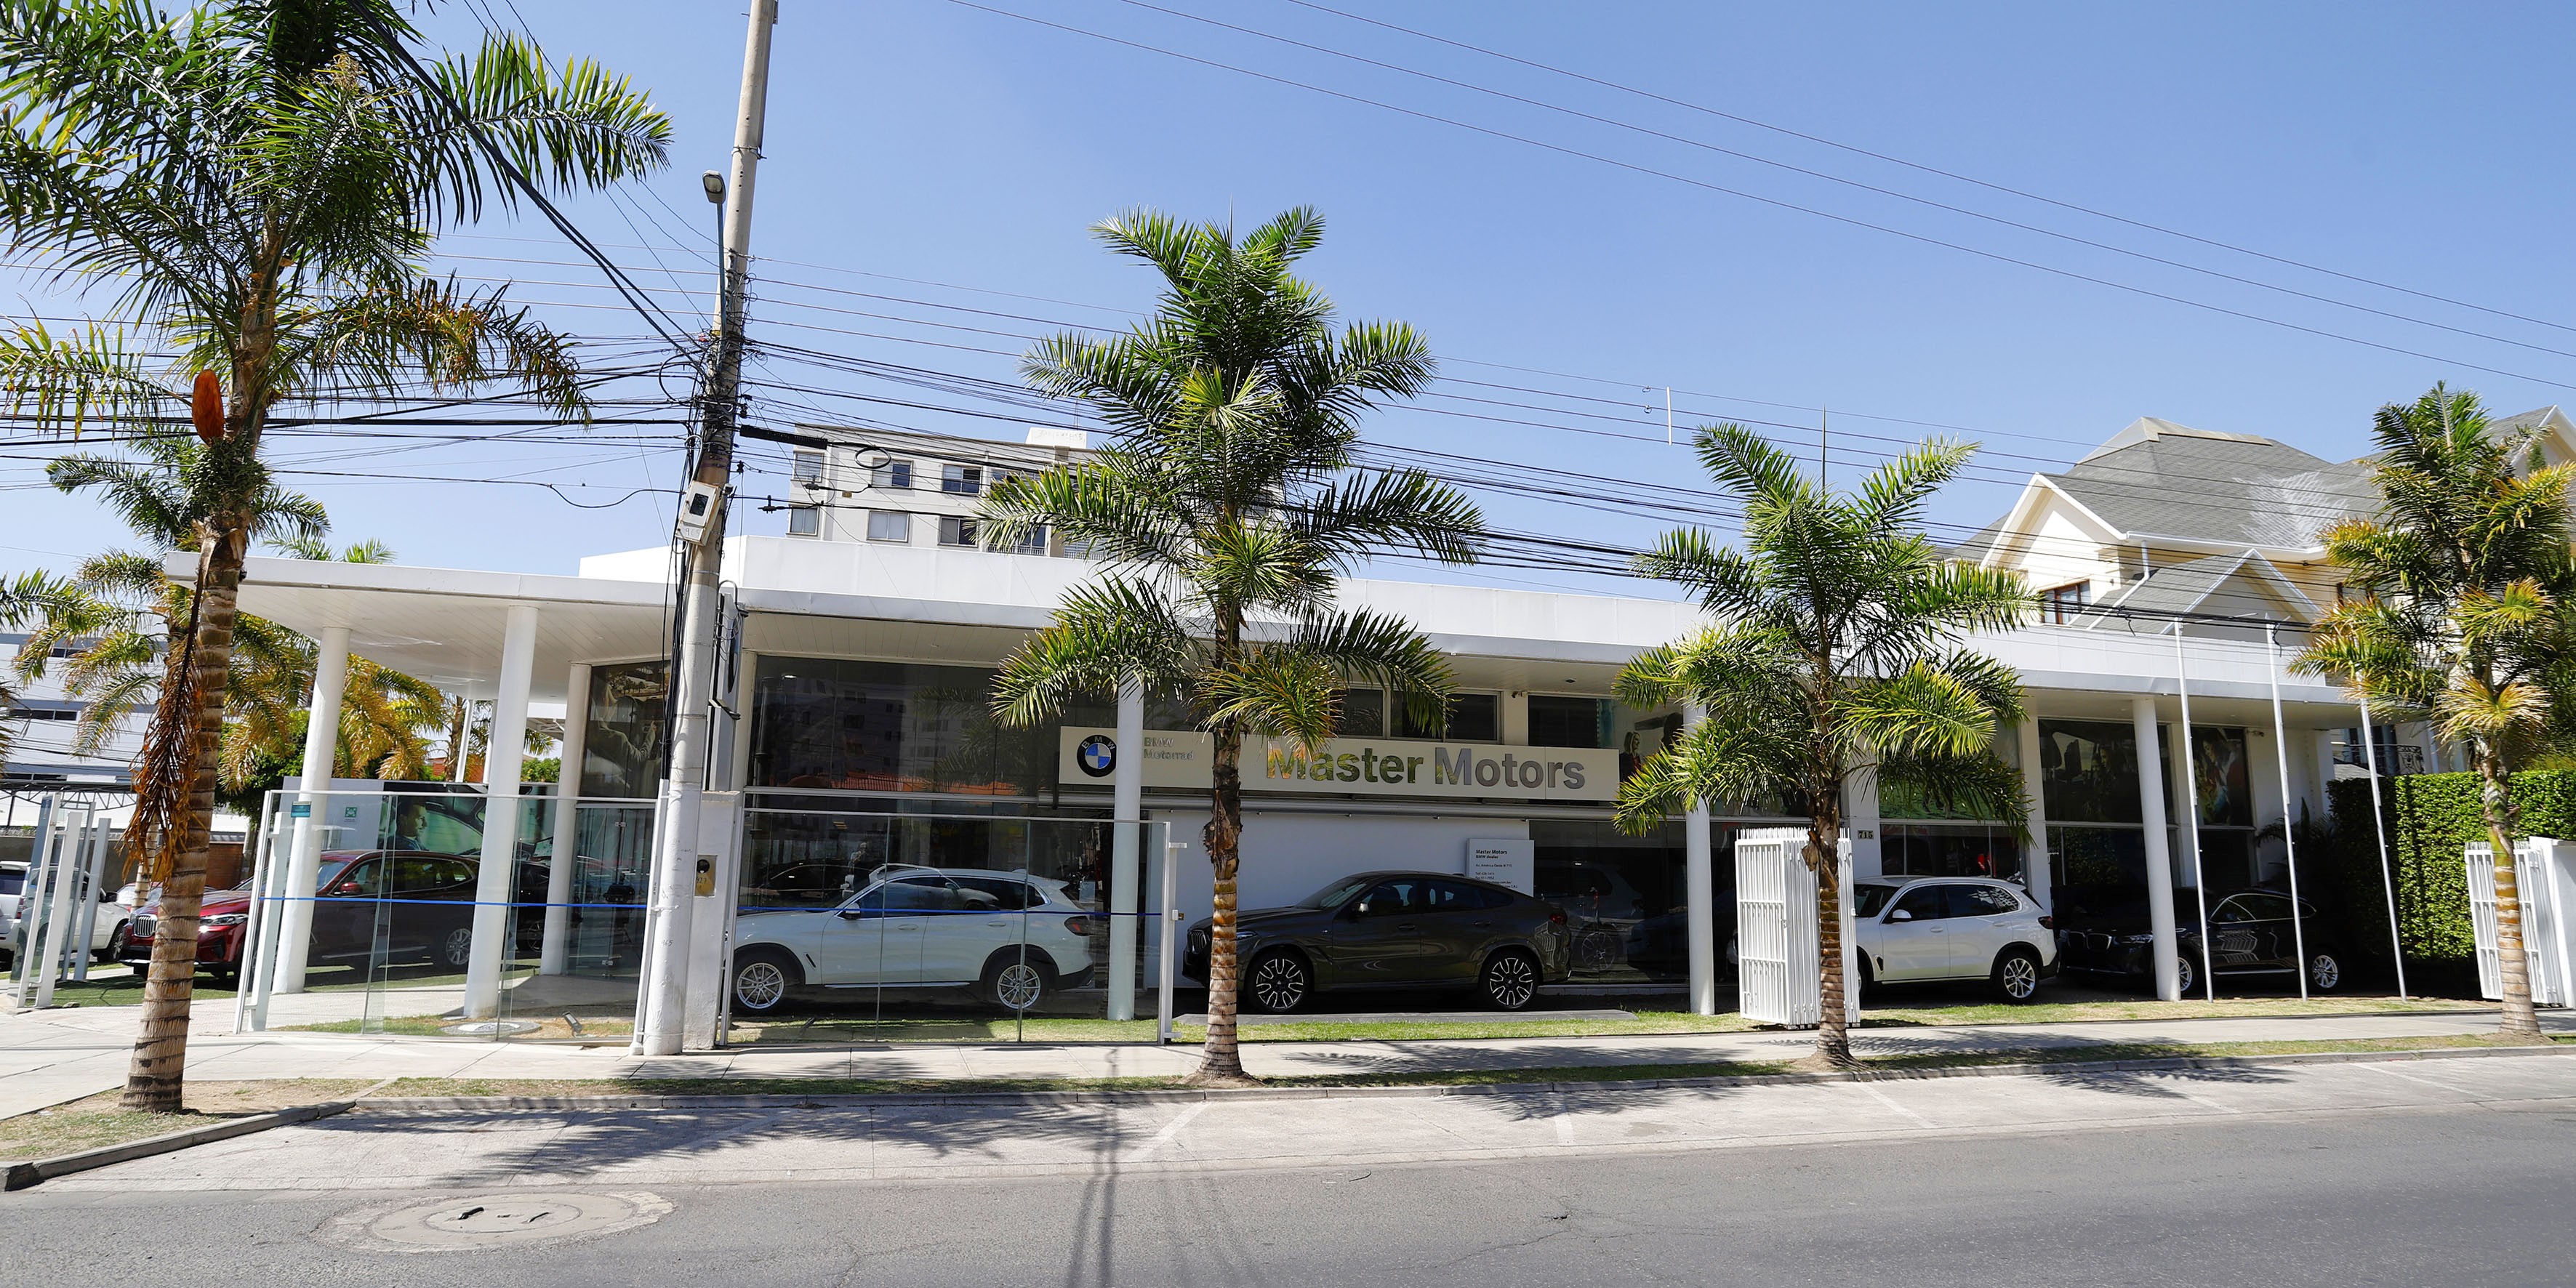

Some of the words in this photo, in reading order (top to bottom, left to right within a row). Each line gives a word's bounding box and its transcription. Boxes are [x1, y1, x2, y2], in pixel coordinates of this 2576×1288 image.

[1144, 736, 1174, 747] BMW
[1144, 749, 1194, 760] Motorrad
[1266, 739, 1424, 784] Master
[1435, 746, 1586, 790] Motors
